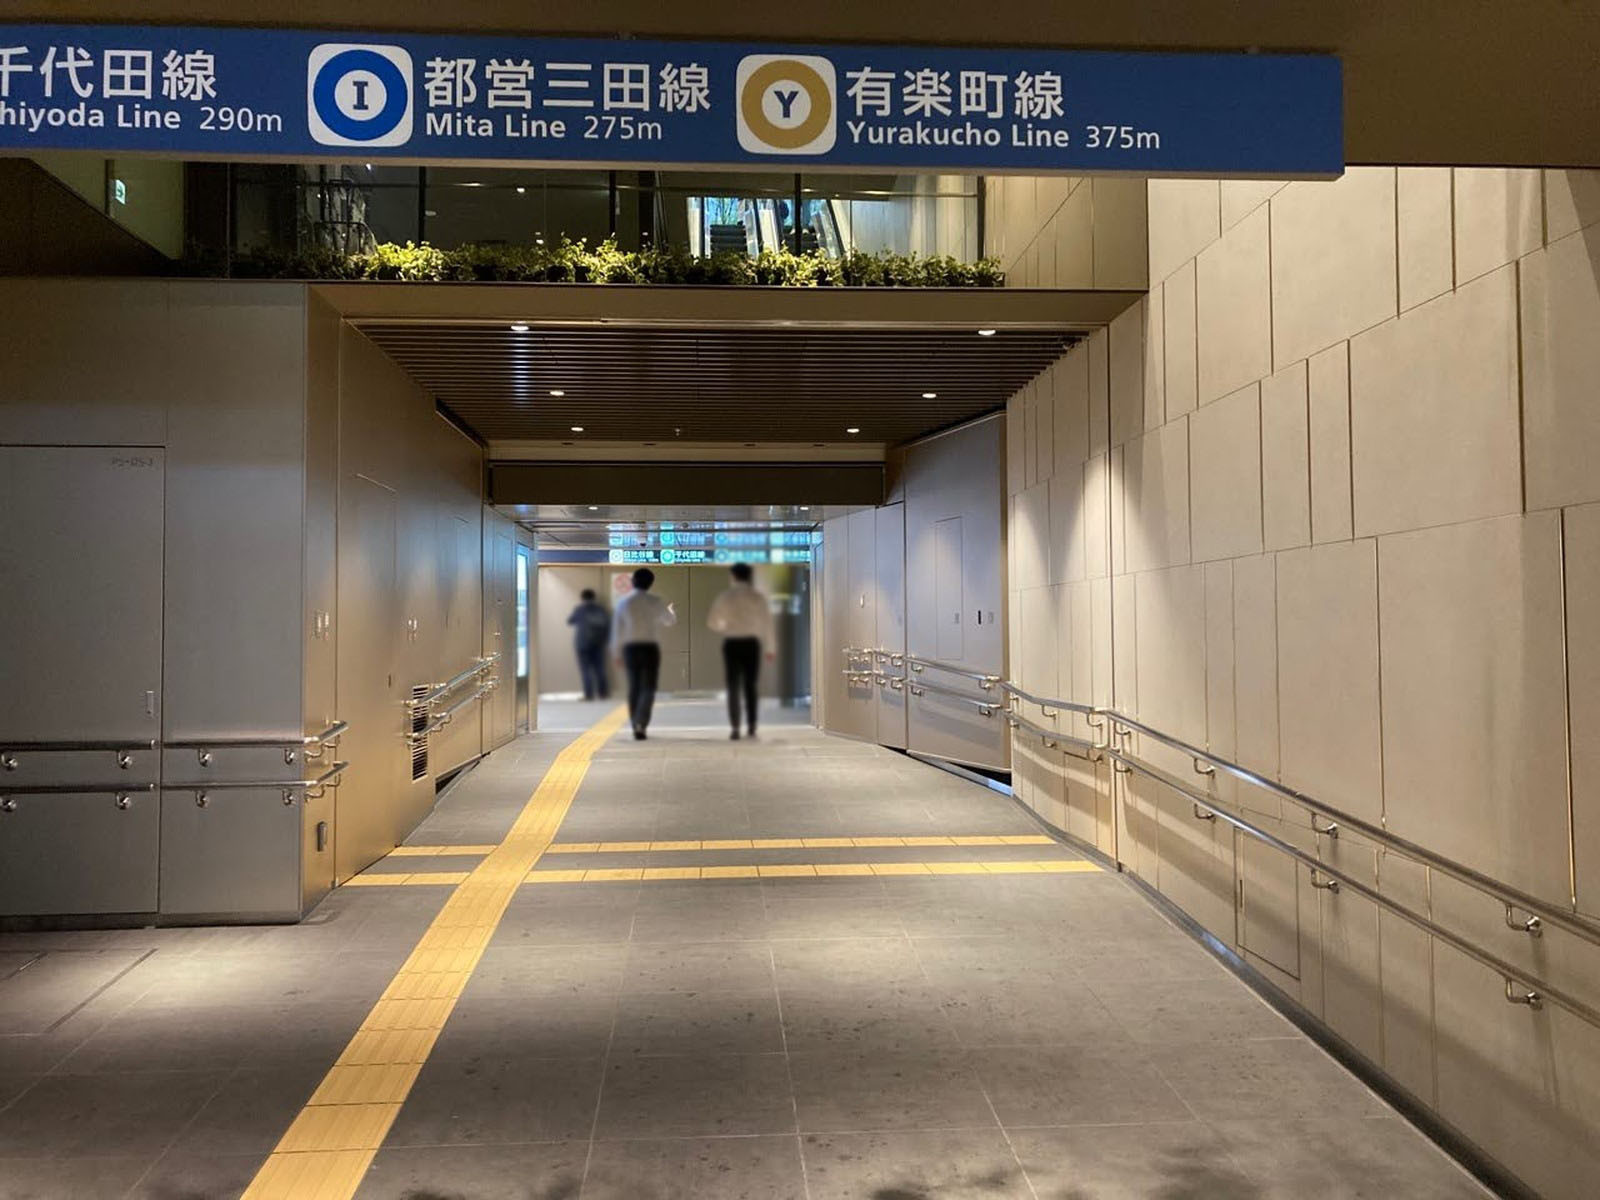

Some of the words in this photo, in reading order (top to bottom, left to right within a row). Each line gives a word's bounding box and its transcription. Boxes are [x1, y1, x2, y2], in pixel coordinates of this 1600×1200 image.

[352, 80, 369, 110] I
[424, 57, 711, 112] 都営三田線
[846, 67, 1065, 119] 有楽町線
[118, 104, 181, 129] Line
[200, 107, 282, 132] 290m
[773, 91, 799, 118] Y
[427, 112, 493, 137] Mita
[506, 114, 566, 138] Line
[584, 116, 662, 140] 275m
[847, 121, 1001, 146] Yurakucho
[1013, 124, 1069, 148] Line
[1086, 126, 1160, 149] 375m
